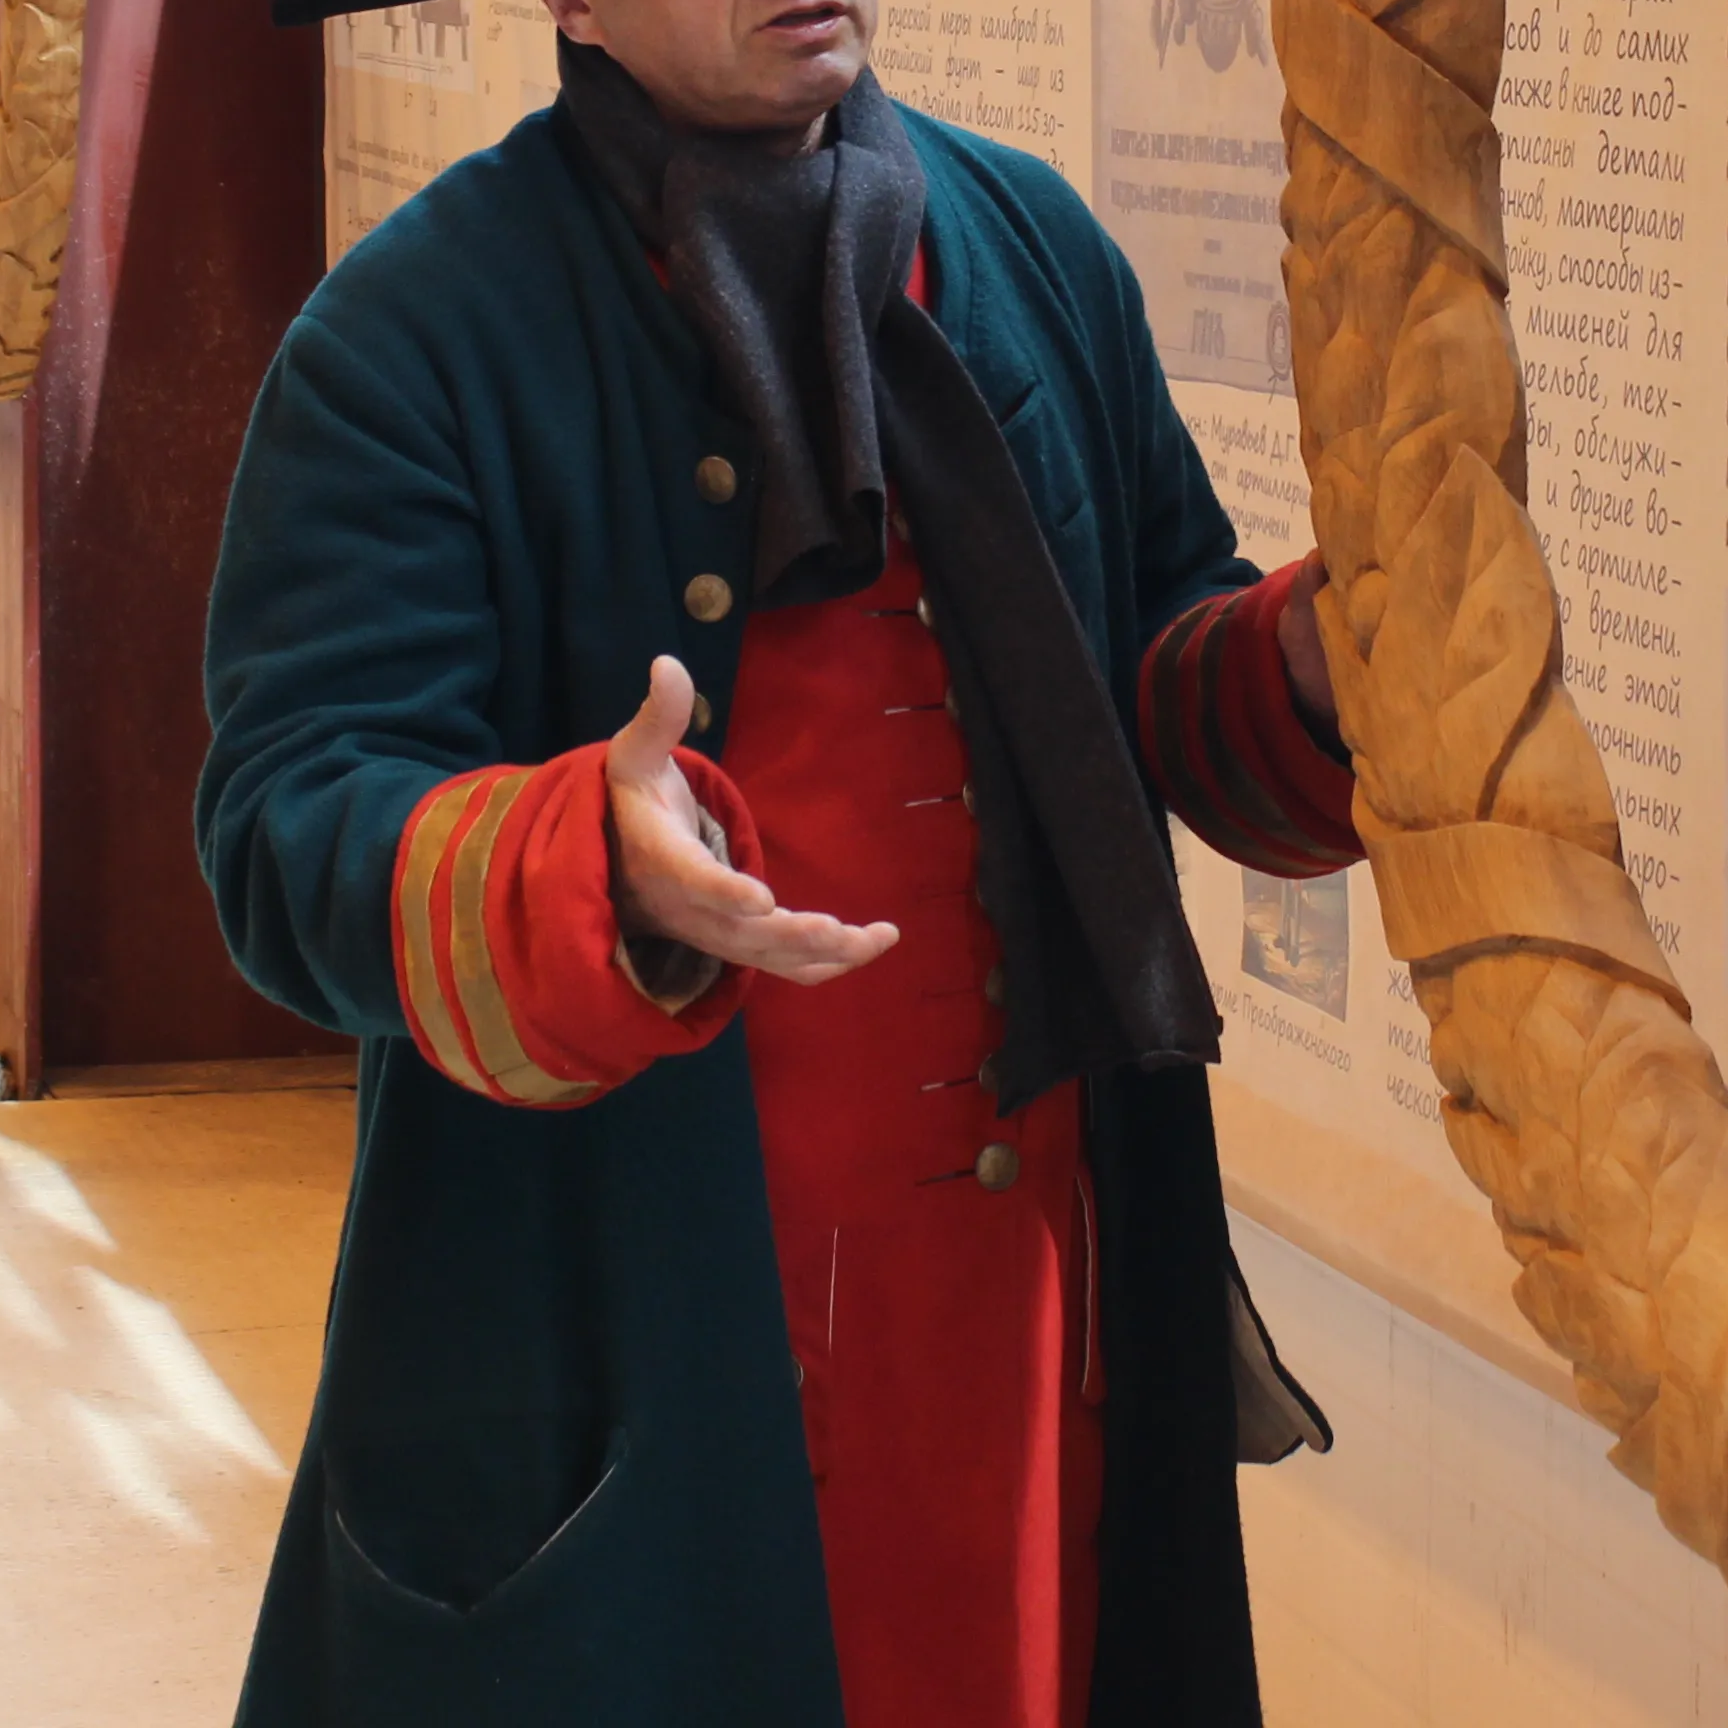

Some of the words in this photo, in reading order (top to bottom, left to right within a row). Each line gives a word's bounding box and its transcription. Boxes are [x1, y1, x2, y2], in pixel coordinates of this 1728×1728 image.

[886, 1, 932, 40] русской
[938, 11, 972, 47] меры
[980, 5, 1039, 54] калибров
[1043, 9, 1065, 47] был
[1558, 26, 1570, 55] и
[1583, 13, 1603, 57] до
[1616, 28, 1690, 65] самих
[945, 45, 982, 90] фунт
[1017, 65, 1041, 102] шар
[1049, 68, 1065, 93] из
[1558, 67, 1569, 113] в
[1573, 79, 1624, 118] книге
[1632, 76, 1688, 122] под-
[976, 90, 1014, 131] весом
[1598, 129, 1686, 184] детали
[1557, 194, 1685, 250] материалы
[1558, 247, 1645, 295] способы
[1649, 270, 1684, 301] из-
[1525, 305, 1629, 352] мишеней
[1645, 312, 1684, 362] для
[1623, 380, 1683, 419] тех-
[1574, 414, 1683, 482] обслужи-
[1545, 479, 1559, 509] и
[1570, 469, 1635, 532] другие
[1645, 487, 1683, 537] во-
[1560, 537, 1571, 568] с
[1578, 542, 1683, 597] артилле-
[1589, 588, 1682, 659] времени.
[1624, 674, 1682, 720] этой
[1242, 993, 1352, 1072] Преображенского
